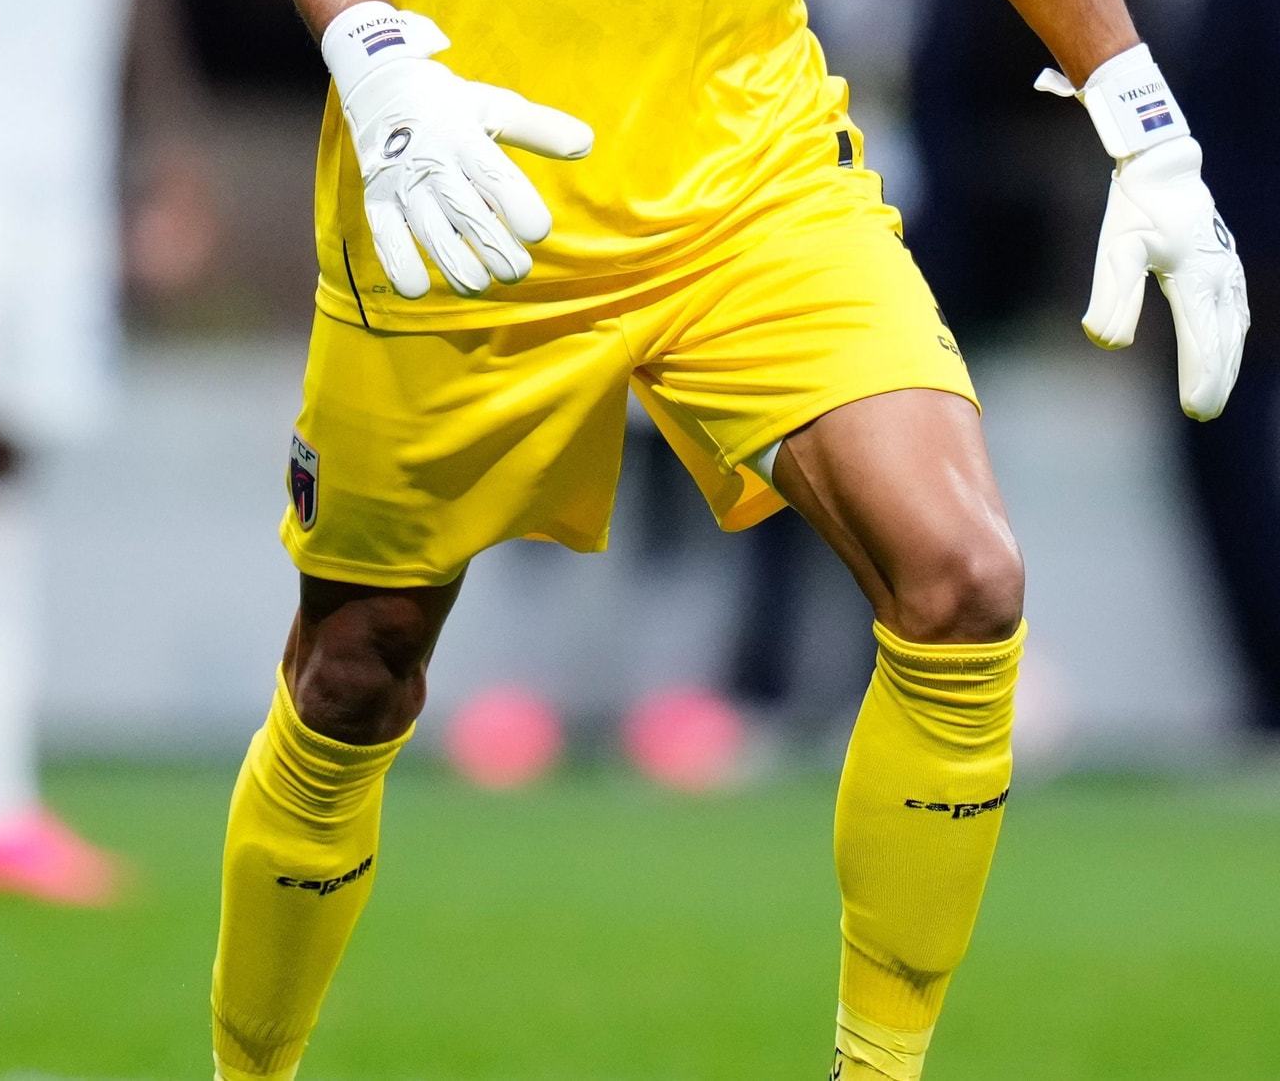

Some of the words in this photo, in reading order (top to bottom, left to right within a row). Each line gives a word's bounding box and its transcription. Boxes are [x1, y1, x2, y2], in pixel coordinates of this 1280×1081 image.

[347, 17, 408, 39] VOZINHA
[292, 435, 315, 462] FCF
[904, 787, 1010, 819] capell
